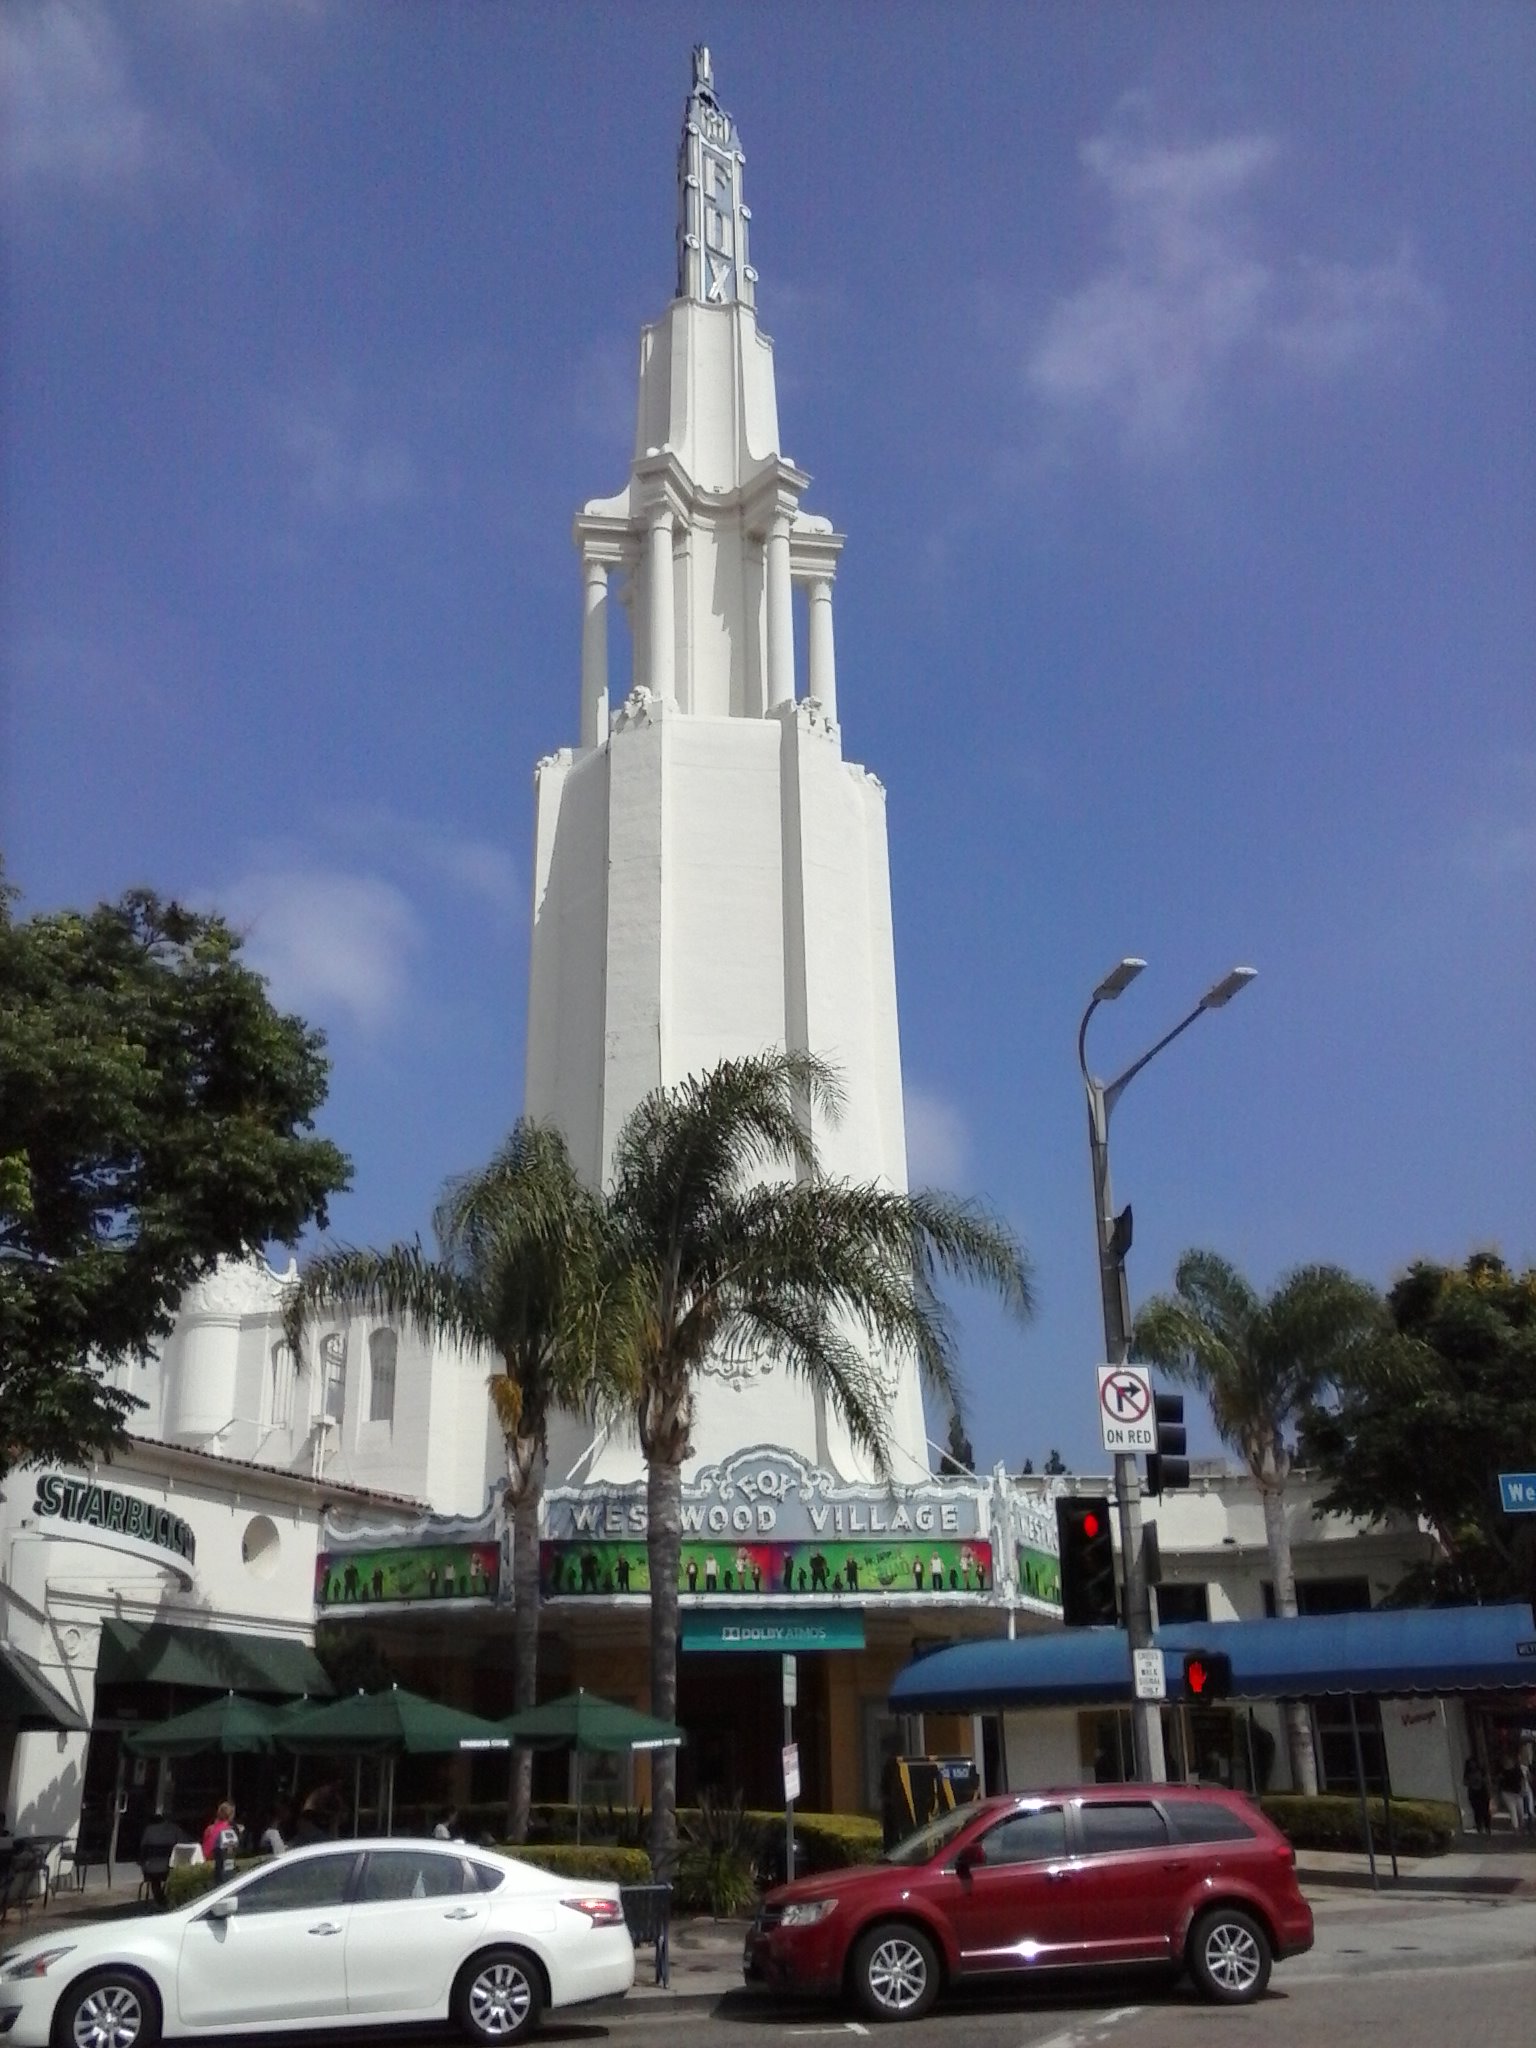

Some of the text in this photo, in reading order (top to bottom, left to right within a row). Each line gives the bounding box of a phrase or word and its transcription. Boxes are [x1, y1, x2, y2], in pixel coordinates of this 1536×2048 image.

[703, 155, 732, 304] FOX
[1107, 1429, 1152, 1444] ON RED
[736, 1470, 797, 1502] FOX
[33, 1474, 196, 1566] STARBUCKS
[571, 1504, 959, 1532] WESWOOD VILLAGE
[741, 1626, 827, 1640] DOLBY ATMOS
